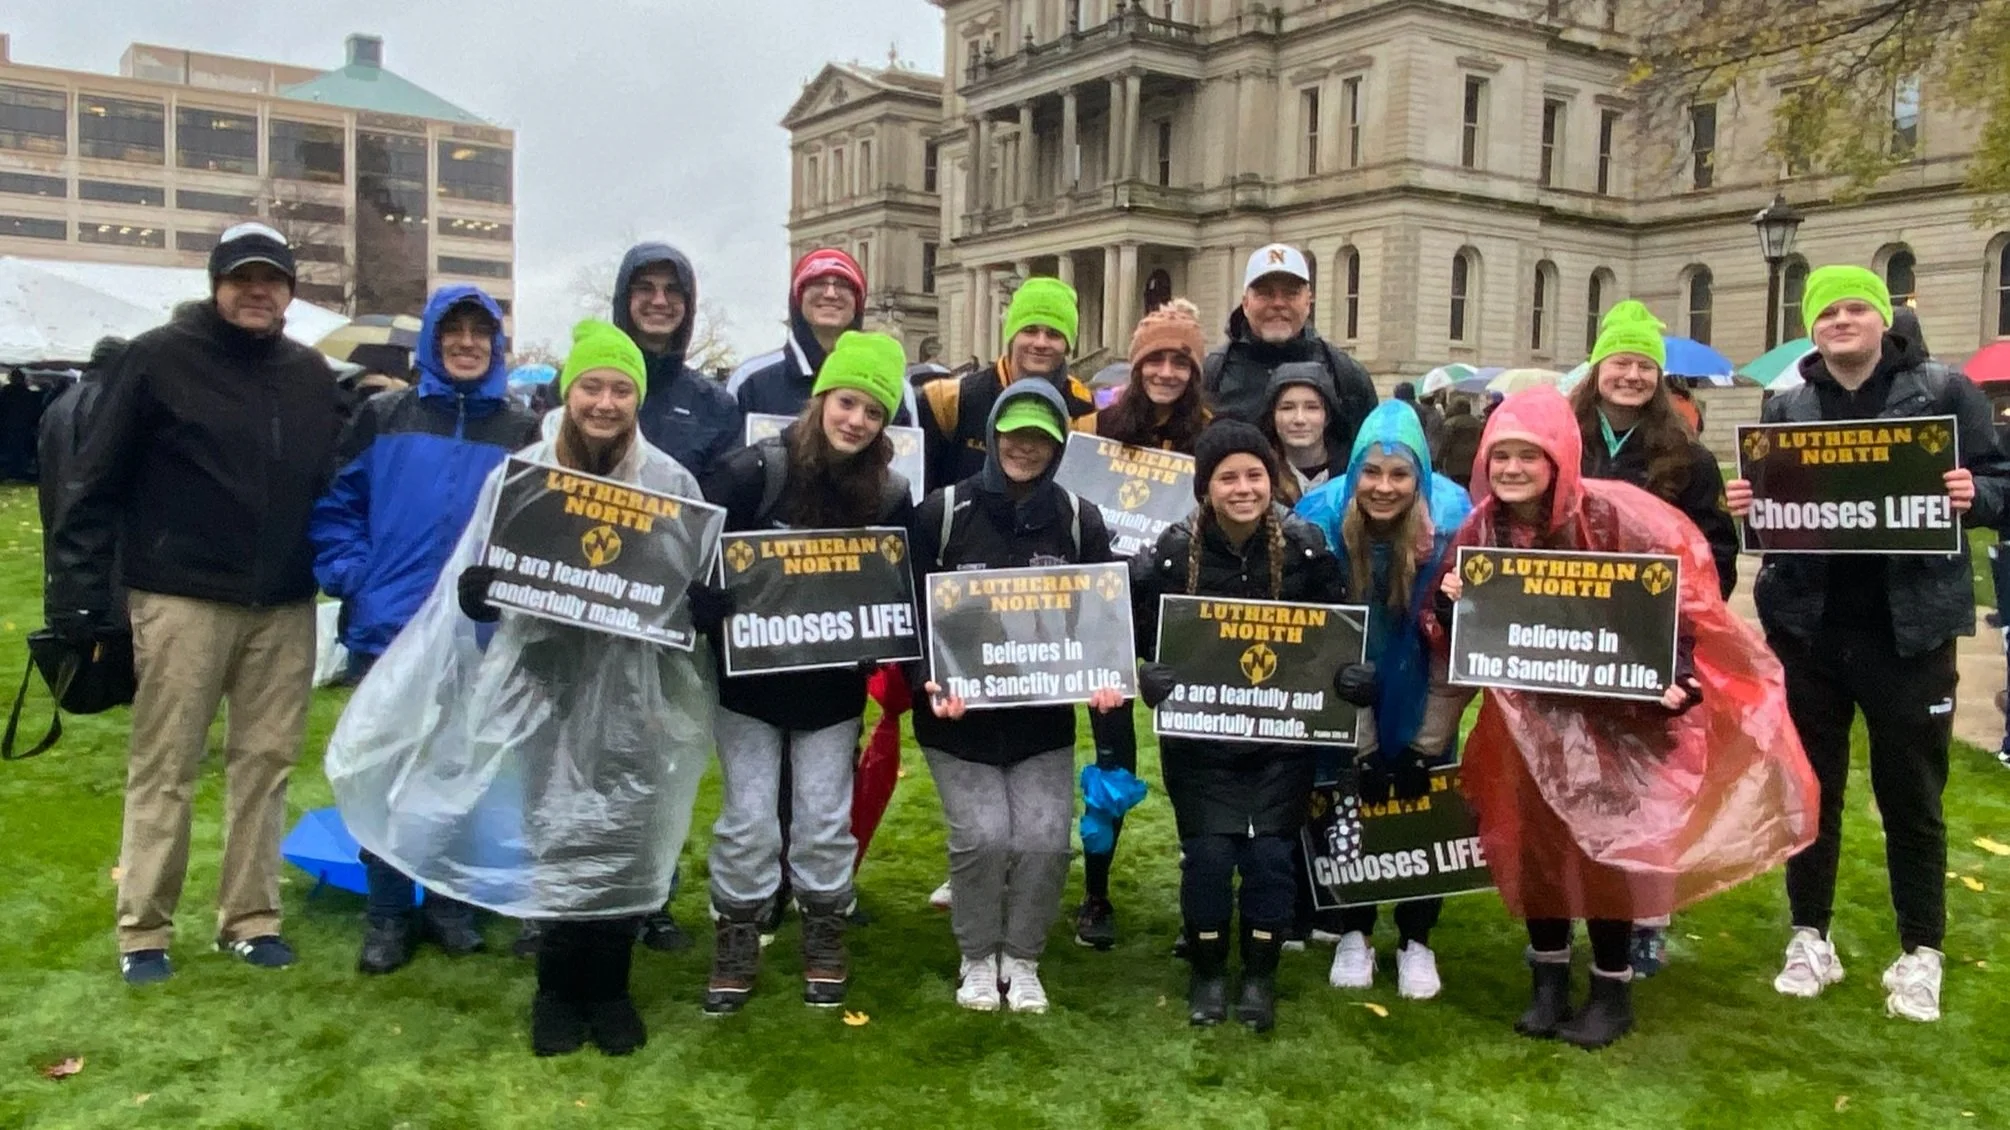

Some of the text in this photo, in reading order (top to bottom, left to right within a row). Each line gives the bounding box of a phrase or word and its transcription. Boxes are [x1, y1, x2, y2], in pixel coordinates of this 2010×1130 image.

[1268, 249, 1287, 265] N
[1778, 427, 1912, 448] LUTHERAN
[1097, 442, 1195, 474] LUTHERAN
[1801, 446, 1890, 465] NORTH
[1109, 458, 1179, 485] NORTH
[545, 471, 681, 519] LUTHERAN
[564, 496, 655, 533] NORTH
[1750, 495, 1952, 530] Chooses LIFE!
[761, 538, 877, 558] LUTHERAN
[488, 545, 664, 605] We are fearfully and
[783, 555, 861, 575] NORTH
[1502, 558, 1637, 581] LUTHERAN
[969, 574, 1091, 596] LUTHERAN
[1523, 577, 1612, 599] NORTH
[488, 581, 641, 632] onderfully made.
[991, 593, 1072, 612] NORTH
[1200, 602, 1326, 626] LUTHERAN
[733, 603, 914, 648] Chooses LIFE!
[1220, 622, 1304, 643] NORTH
[1508, 623, 1619, 653] Believes in
[982, 638, 1082, 665] Believes in
[947, 667, 1127, 698] The Sanctity of Life.
[1468, 653, 1663, 690] The Sanctity of Life.
[1167, 684, 1324, 711] e are fearfully and
[1160, 711, 1256, 737] wonderfully
[1259, 717, 1309, 738] made.
